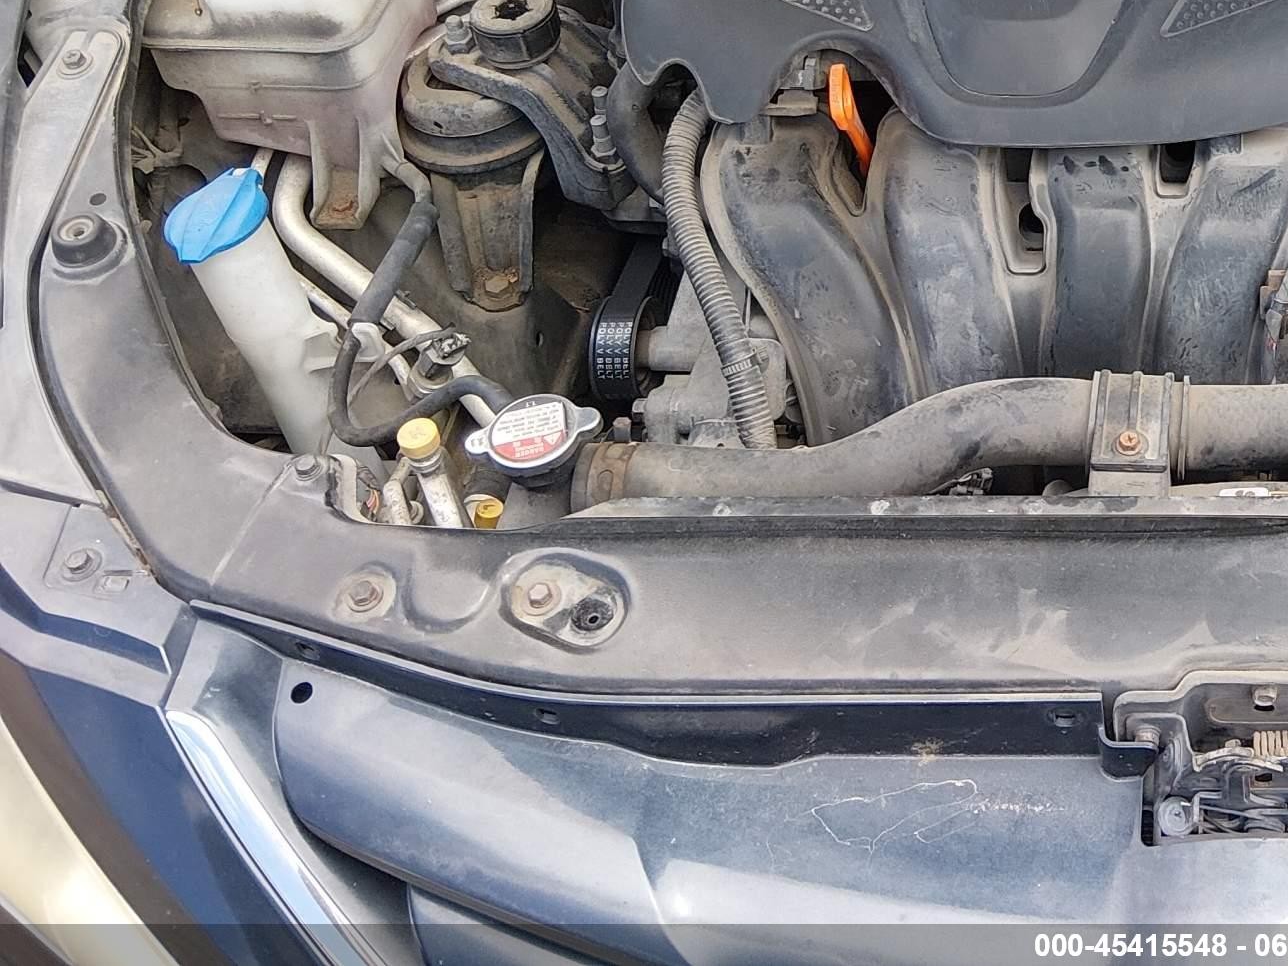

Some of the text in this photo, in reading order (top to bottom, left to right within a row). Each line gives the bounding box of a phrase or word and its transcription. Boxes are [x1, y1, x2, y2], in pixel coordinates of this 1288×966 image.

[596, 357, 606, 379] BELT
[605, 357, 614, 379] BELT
[614, 357, 623, 379] BELT
